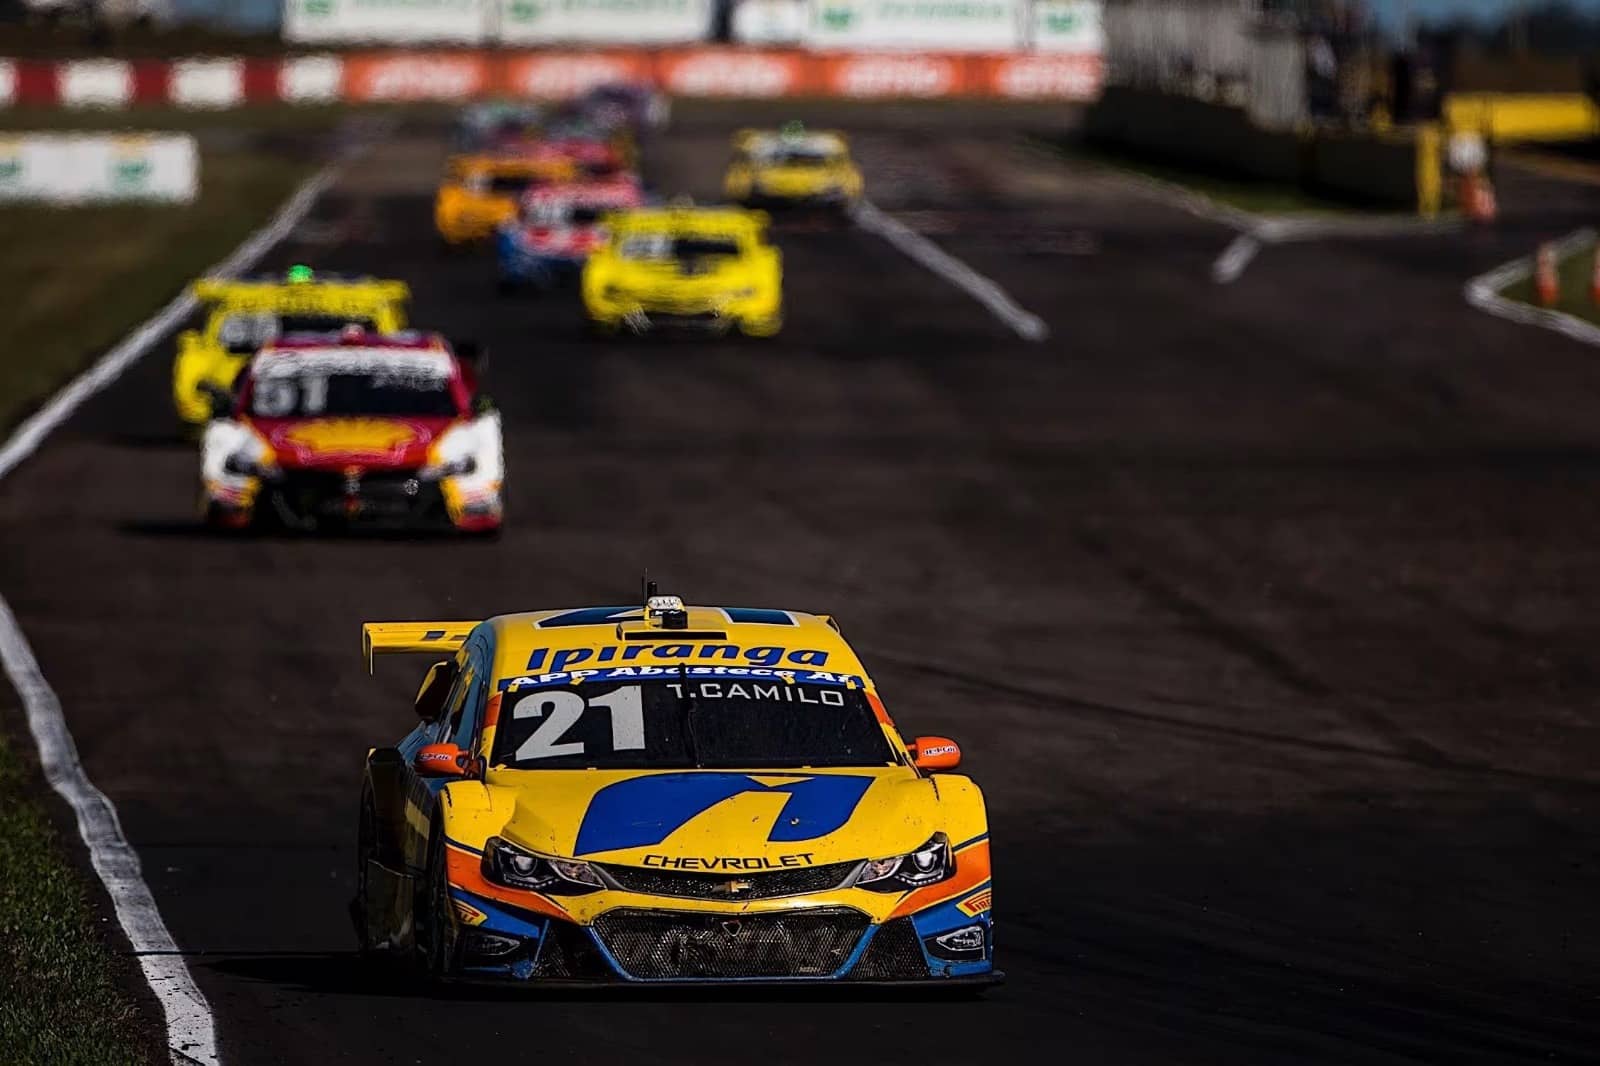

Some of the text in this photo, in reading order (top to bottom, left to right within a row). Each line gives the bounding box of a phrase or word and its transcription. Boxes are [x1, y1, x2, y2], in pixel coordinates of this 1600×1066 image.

[526, 643, 829, 672] Ipiranga
[666, 683, 844, 706] T.CAMILO
[513, 684, 646, 761] 21
[643, 852, 814, 869] CHEVROLET
